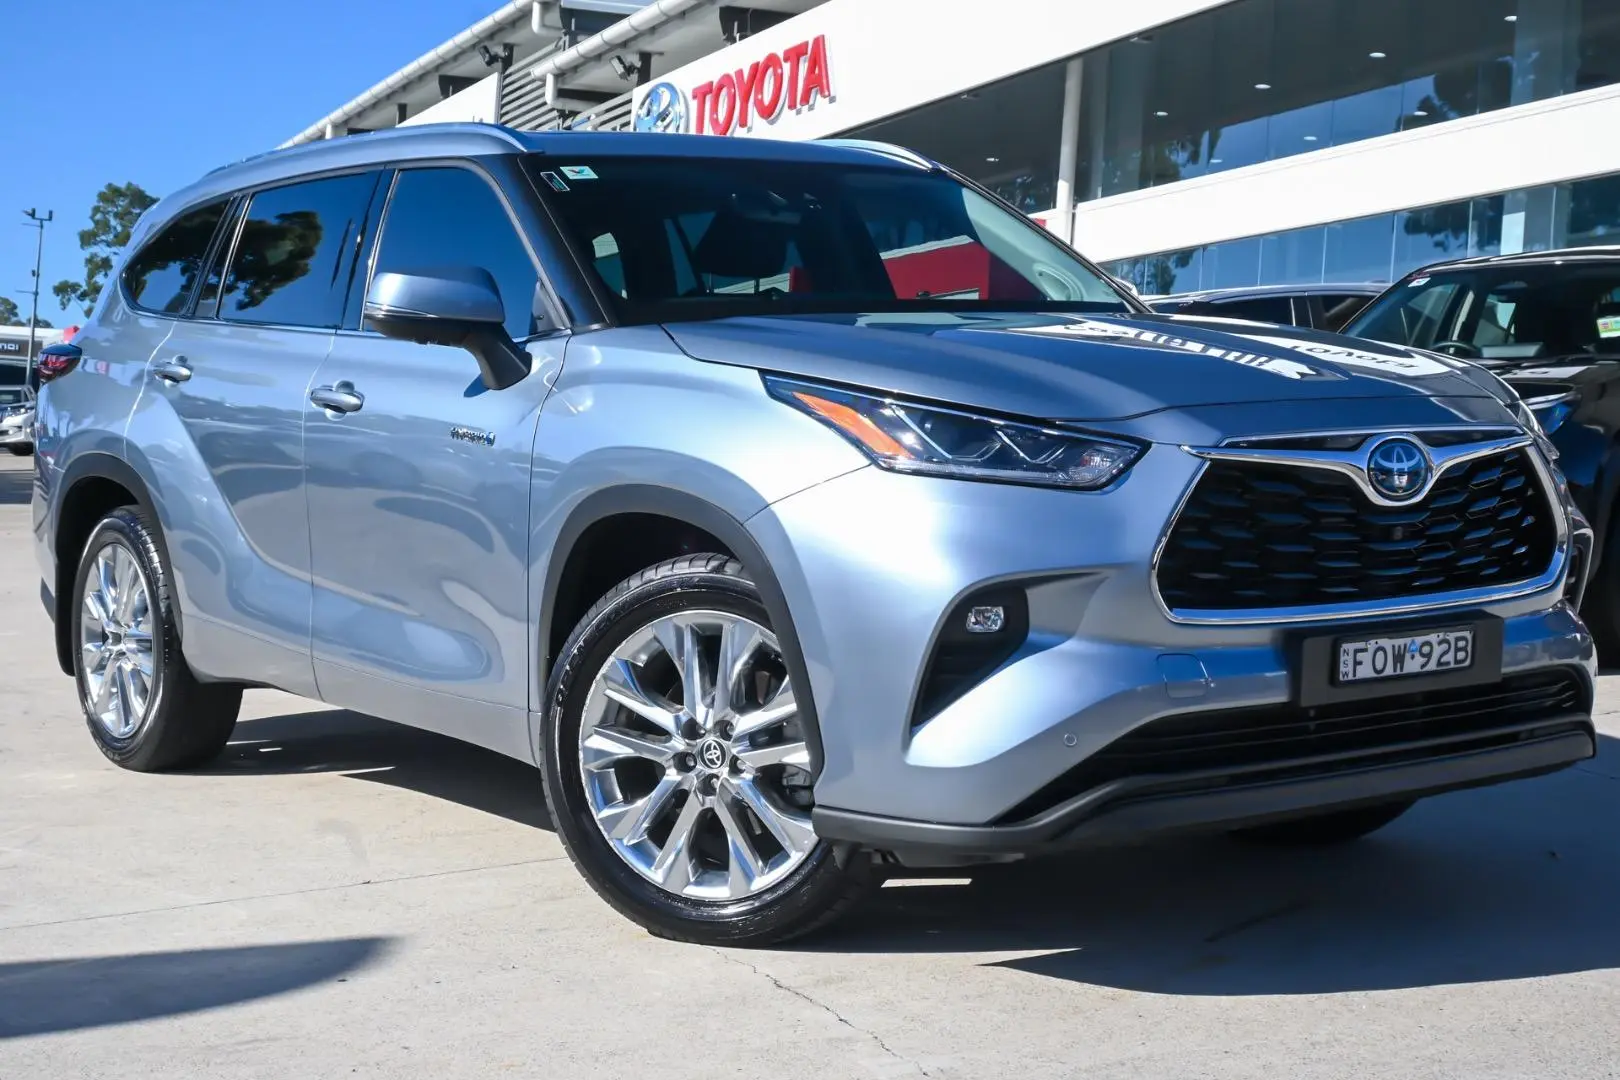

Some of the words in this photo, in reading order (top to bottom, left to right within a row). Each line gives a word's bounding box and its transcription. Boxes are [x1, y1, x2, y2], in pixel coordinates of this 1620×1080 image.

[692, 34, 830, 136] TOYOTA
[1341, 648, 1350, 680] NSW
[1352, 643, 1407, 678] FOW
[1418, 636, 1470, 670] 92B
